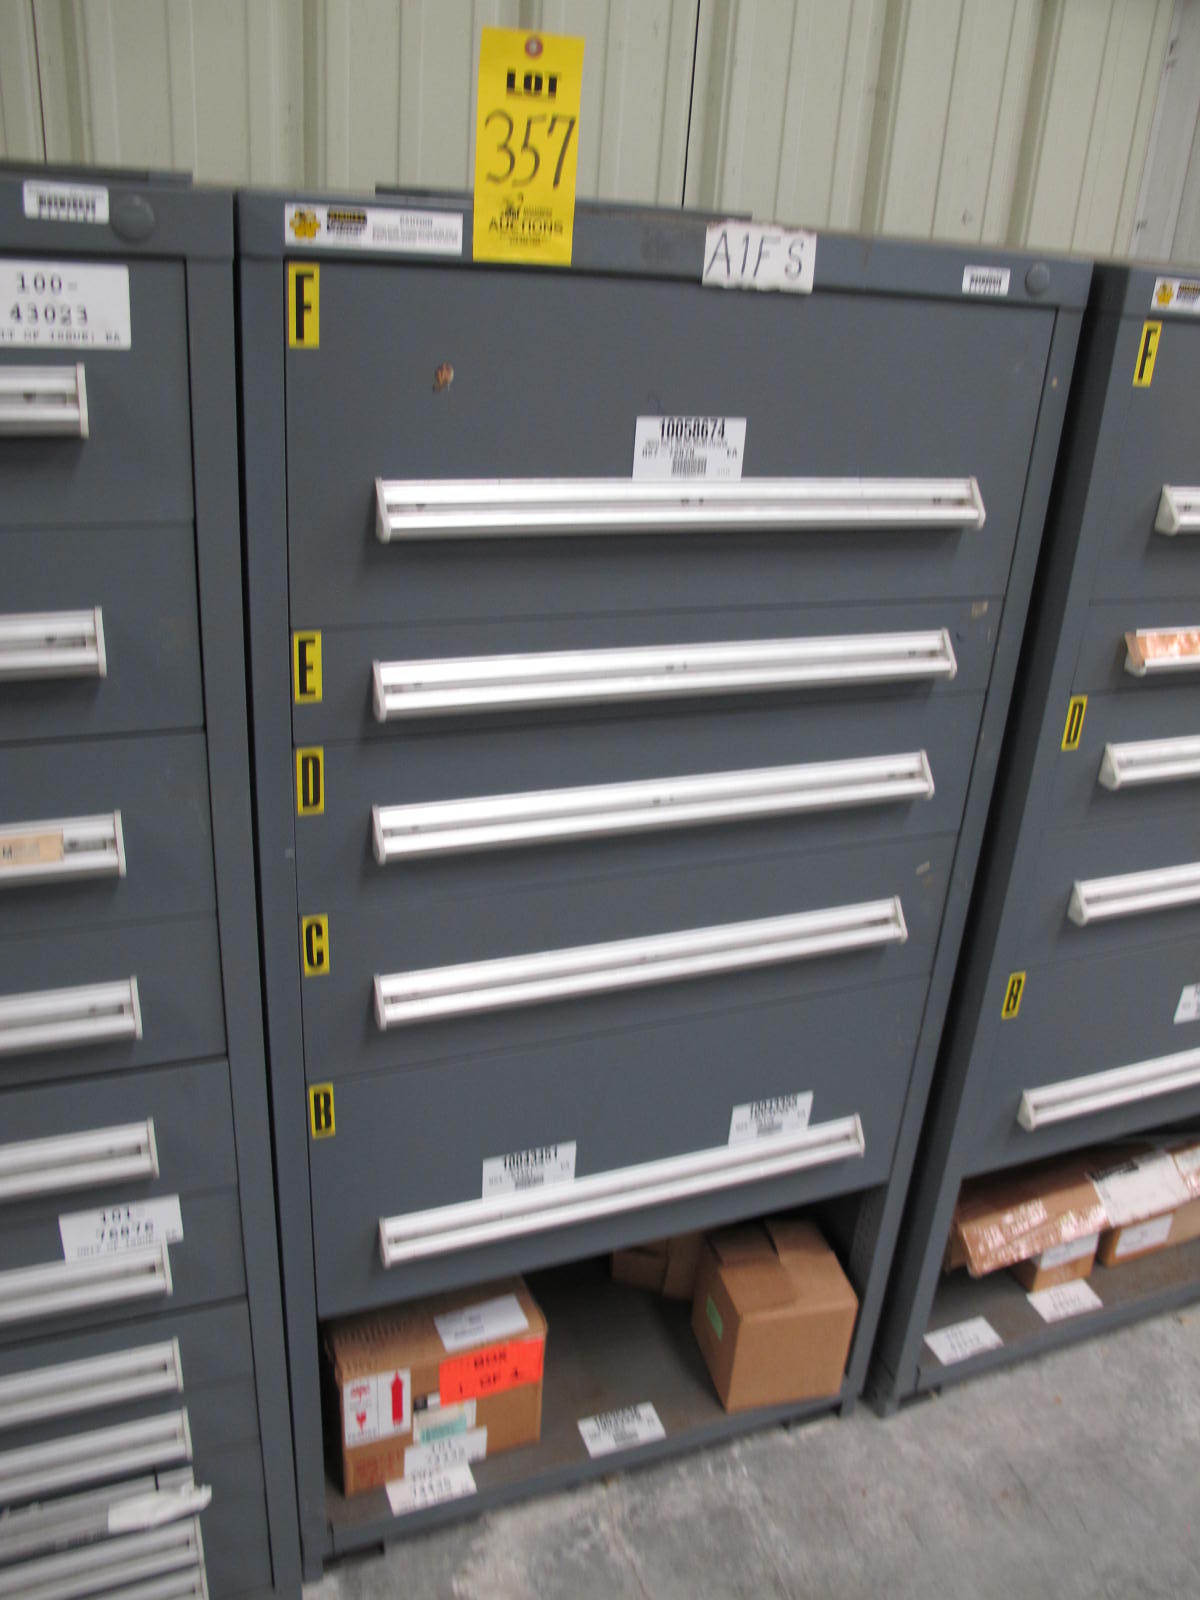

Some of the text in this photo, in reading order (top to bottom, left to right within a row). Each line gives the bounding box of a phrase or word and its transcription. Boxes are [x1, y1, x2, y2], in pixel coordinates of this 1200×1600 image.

[506, 68, 561, 100] LOT
[484, 108, 576, 190] 357
[488, 214, 563, 237] AUCTIONS
[10, 303, 88, 328] 43023
[296, 271, 314, 344] F
[1137, 328, 1158, 382] F
[660, 416, 726, 443] 10058674
[298, 637, 316, 696] E
[302, 755, 321, 808] D
[305, 922, 324, 968] C
